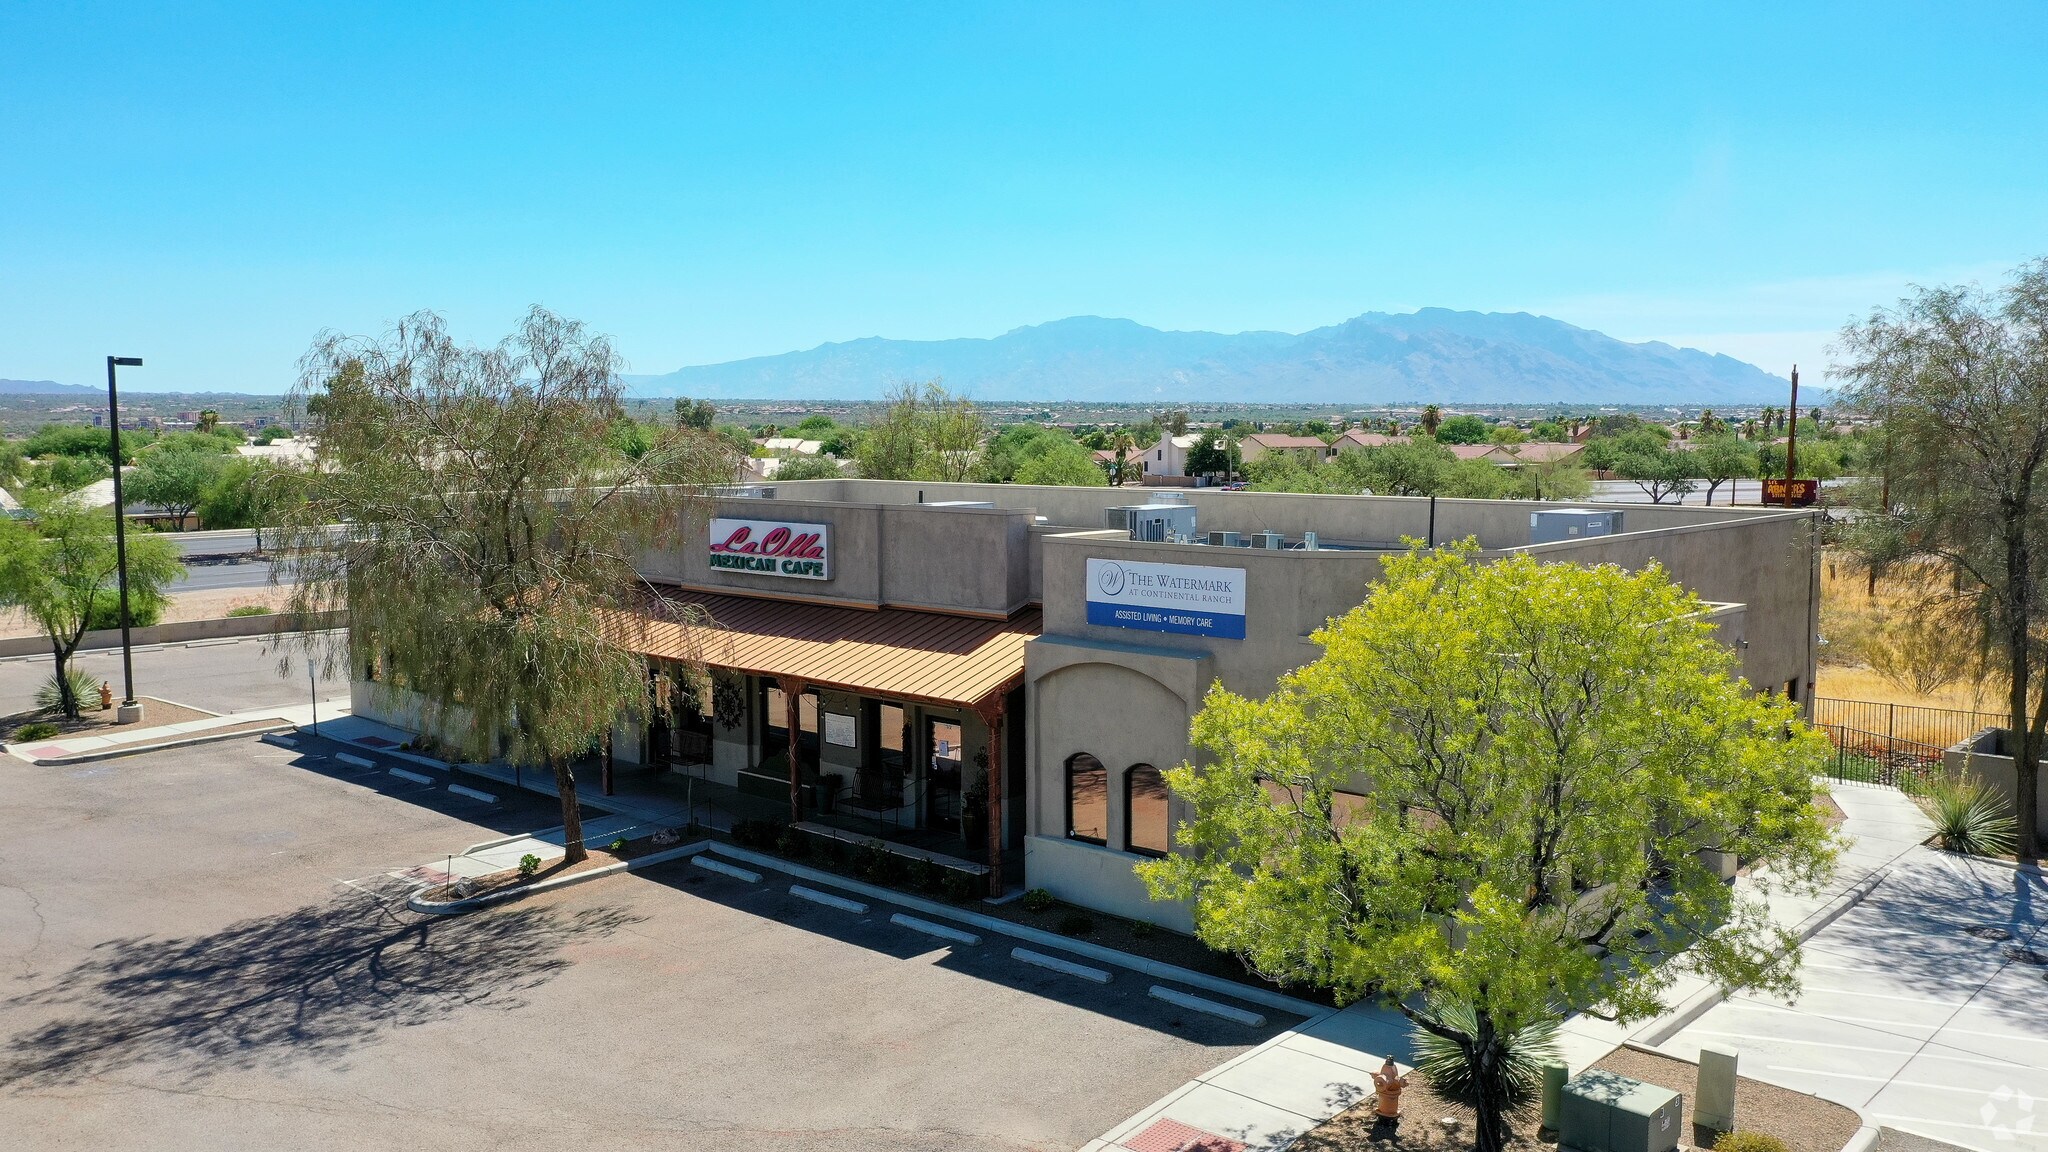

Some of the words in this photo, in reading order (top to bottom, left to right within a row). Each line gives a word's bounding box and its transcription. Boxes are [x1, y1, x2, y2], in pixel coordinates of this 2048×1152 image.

[1768, 483, 1805, 494] ABNR'S
[710, 526, 760, 554] La
[760, 526, 825, 559] Olla
[709, 554, 777, 572] MEXICAN
[781, 560, 824, 577] CAFE
[1141, 590, 1200, 602] CONTINENTAL
[1202, 594, 1232, 604] RANCH
[1115, 610, 1142, 621] ASSISTED
[1143, 612, 1162, 623] LIVING
[1169, 615, 1195, 627] MEMORY
[1196, 618, 1213, 628] CARE
